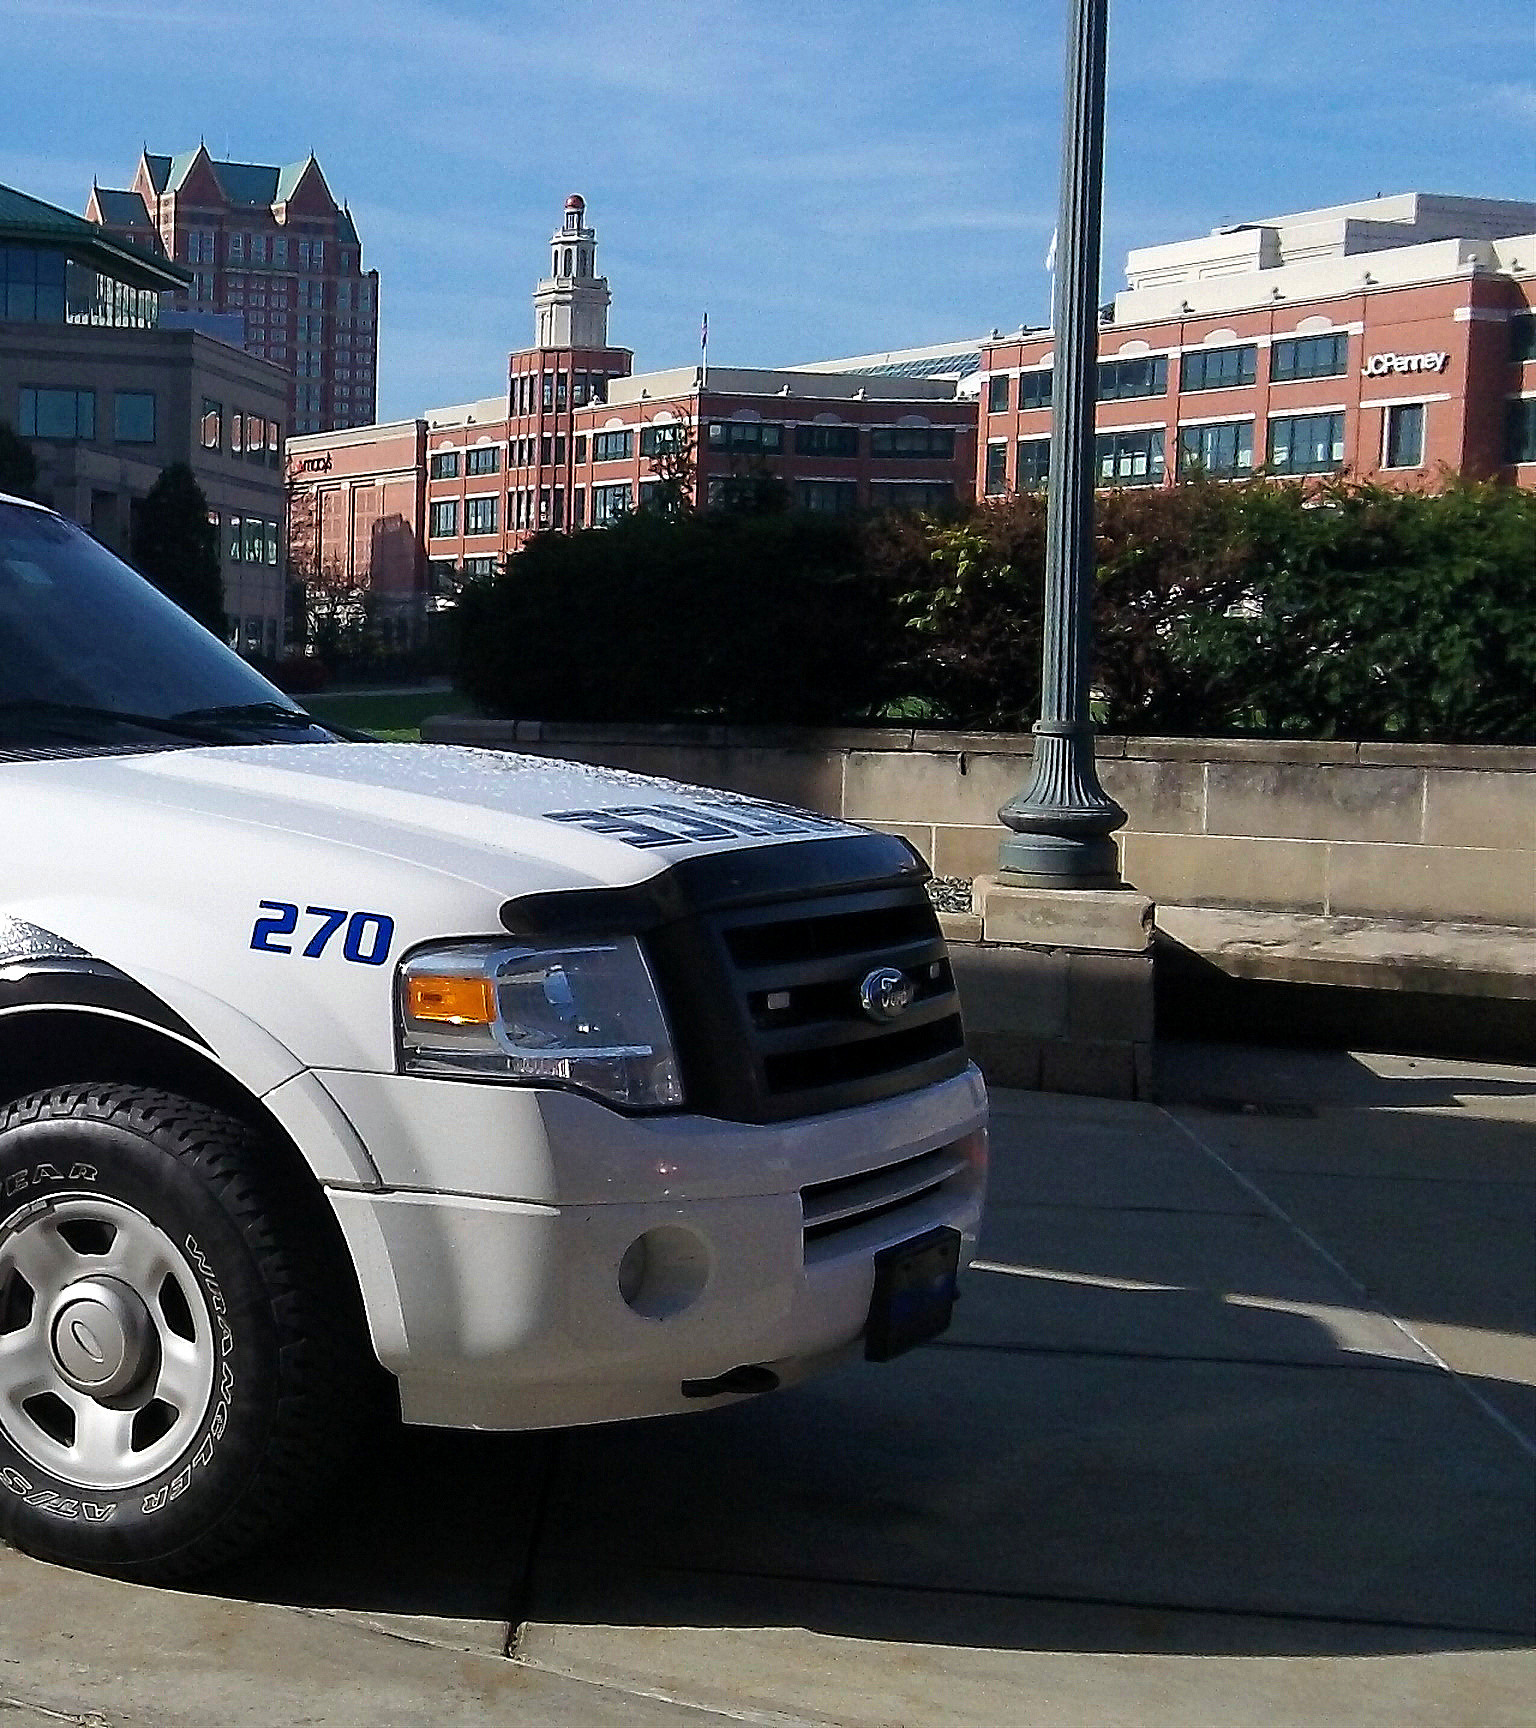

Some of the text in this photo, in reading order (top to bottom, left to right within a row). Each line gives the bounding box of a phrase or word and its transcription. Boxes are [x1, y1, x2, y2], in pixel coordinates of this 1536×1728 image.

[1361, 352, 1449, 376] JCPenney
[249, 899, 395, 967] 270
[141, 1233, 236, 1514] WRANGLER
